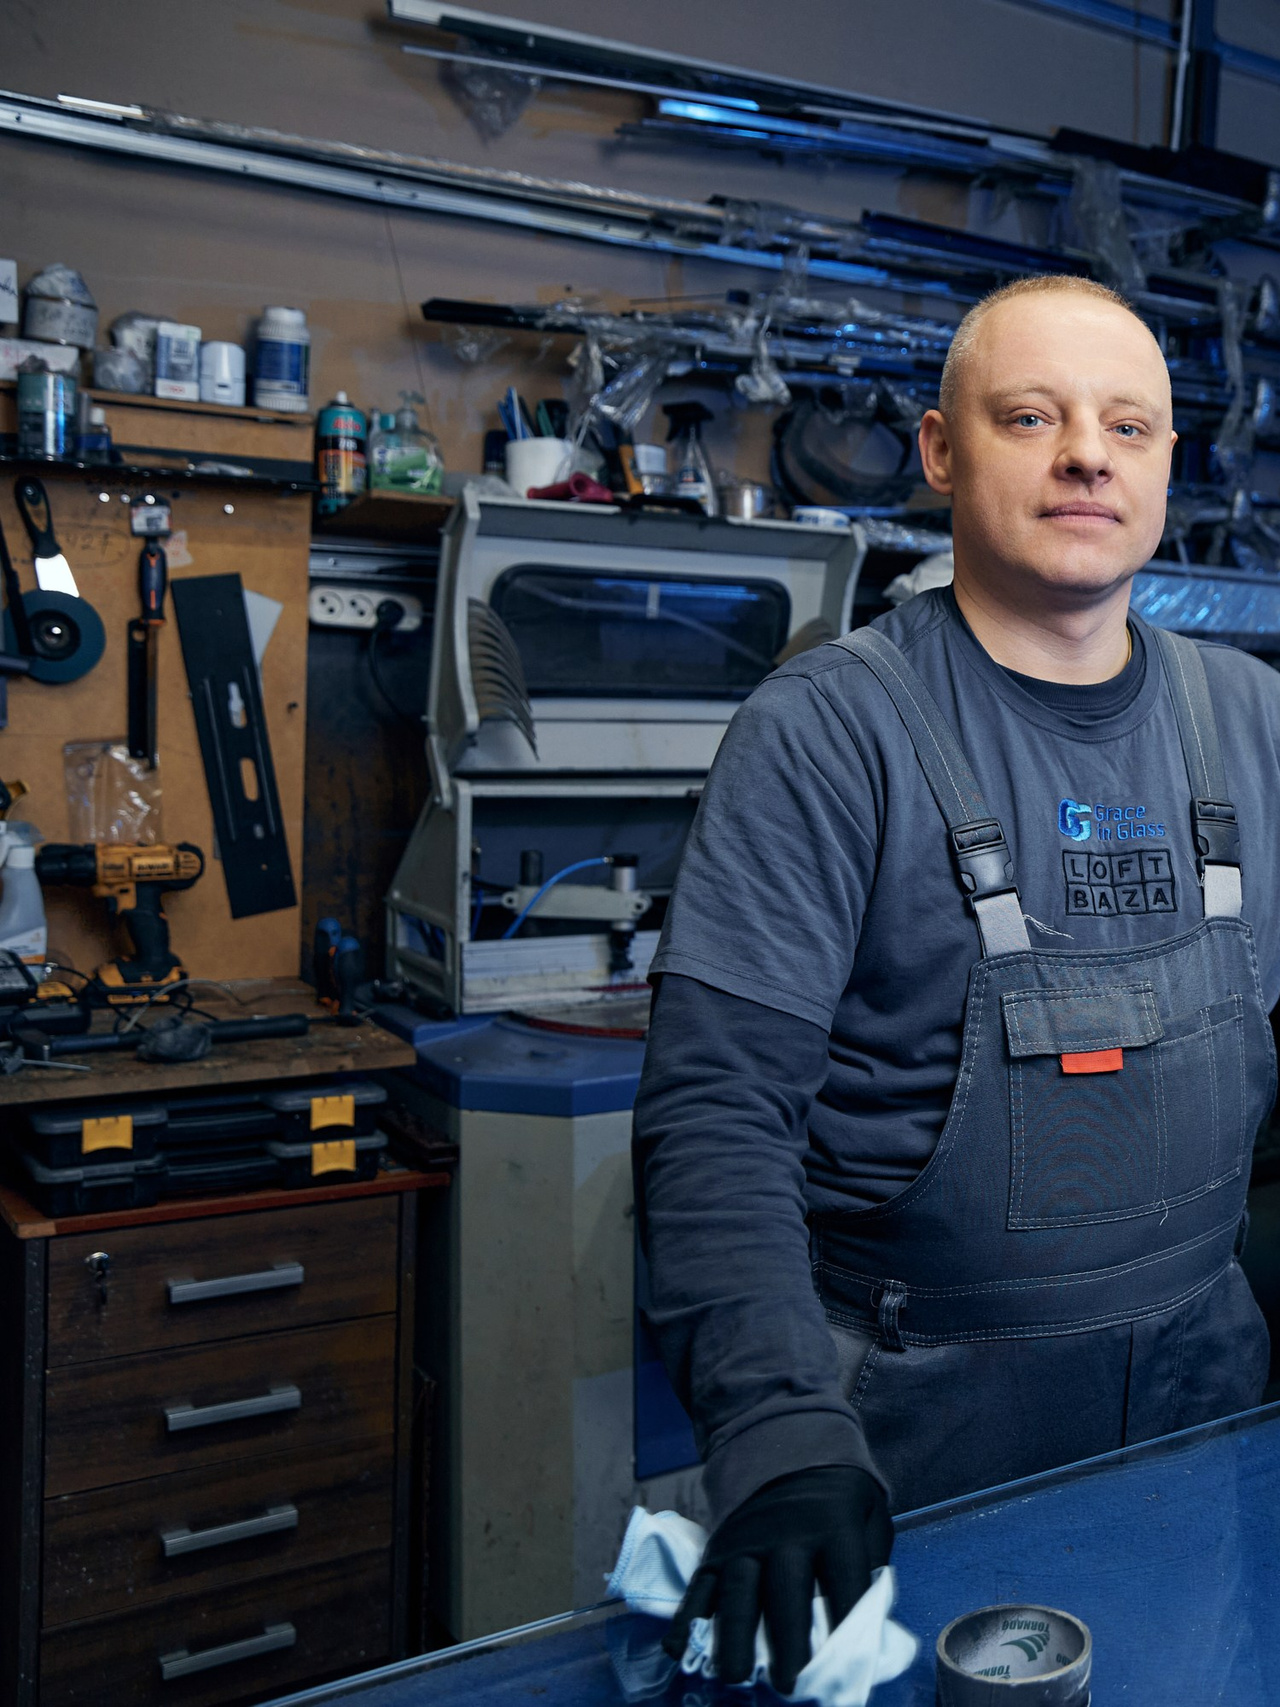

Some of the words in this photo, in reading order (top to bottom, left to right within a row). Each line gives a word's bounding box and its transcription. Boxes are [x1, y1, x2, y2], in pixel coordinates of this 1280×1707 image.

[1094, 804, 1146, 822] Grace
[1096, 823, 1112, 841] in
[1116, 821, 1166, 841] Glass
[1070, 857, 1163, 880] LOFT
[1074, 888, 1169, 909] BAZA
[1002, 1620, 1049, 1632] TORNADO
